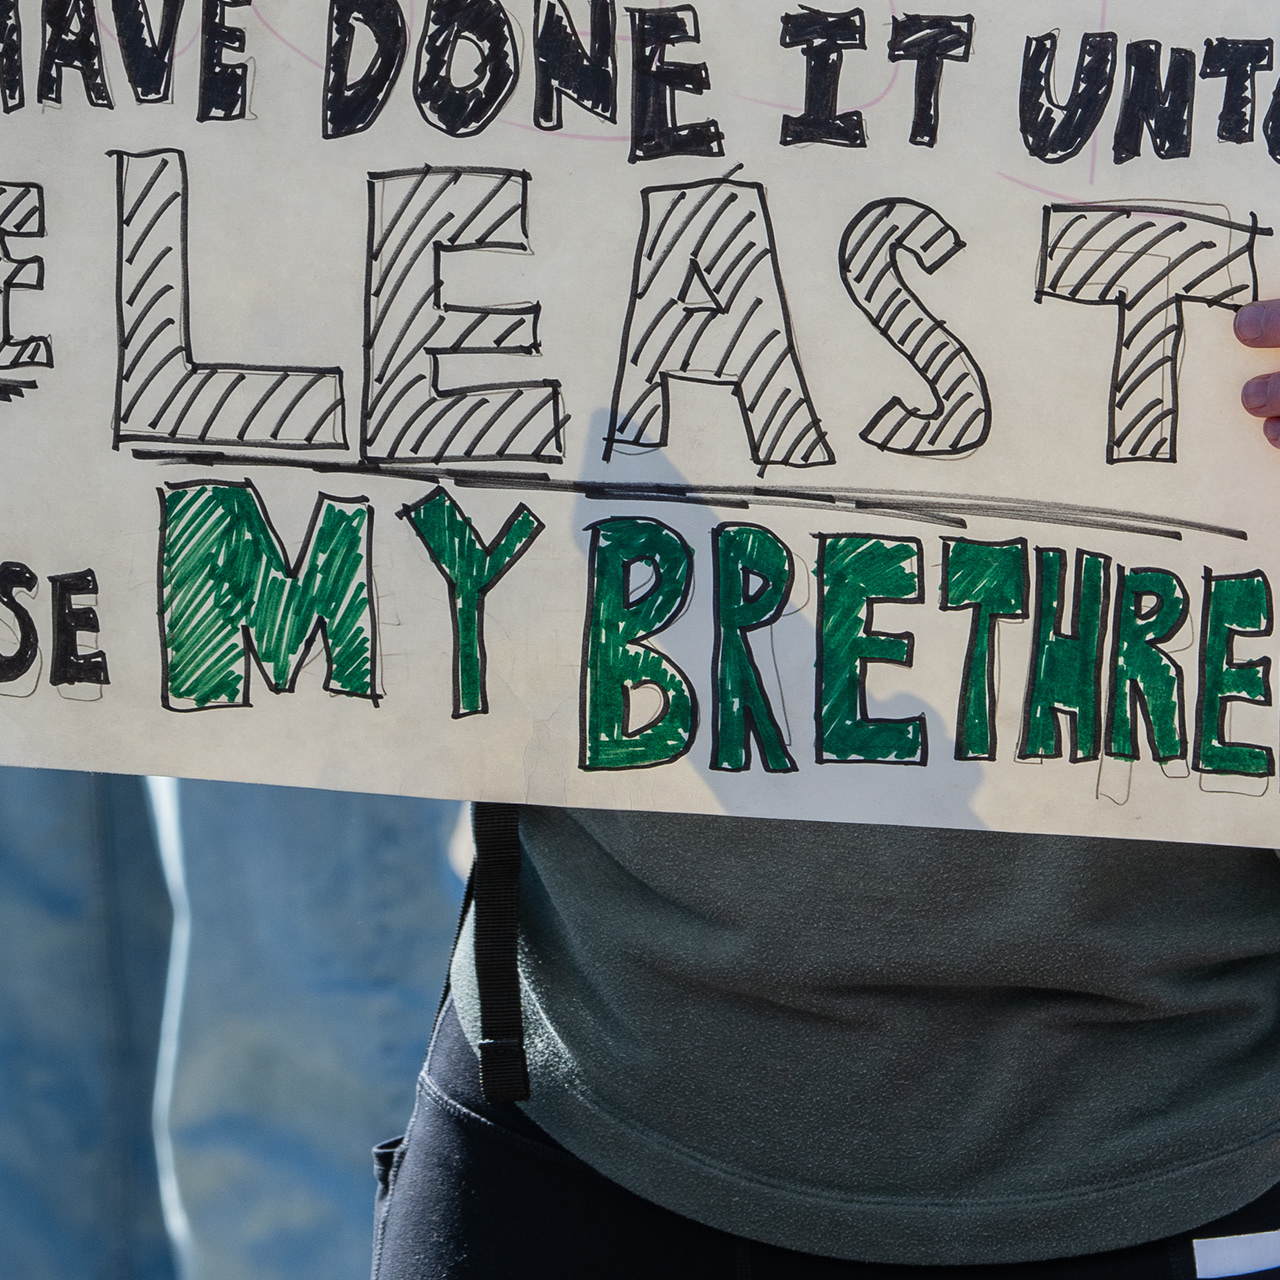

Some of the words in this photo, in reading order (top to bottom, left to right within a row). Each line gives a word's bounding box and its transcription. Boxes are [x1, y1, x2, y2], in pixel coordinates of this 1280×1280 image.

[780, 4, 975, 149] IT
[107, 149, 1272, 472] LEAST
[158, 478, 546, 718] MY
